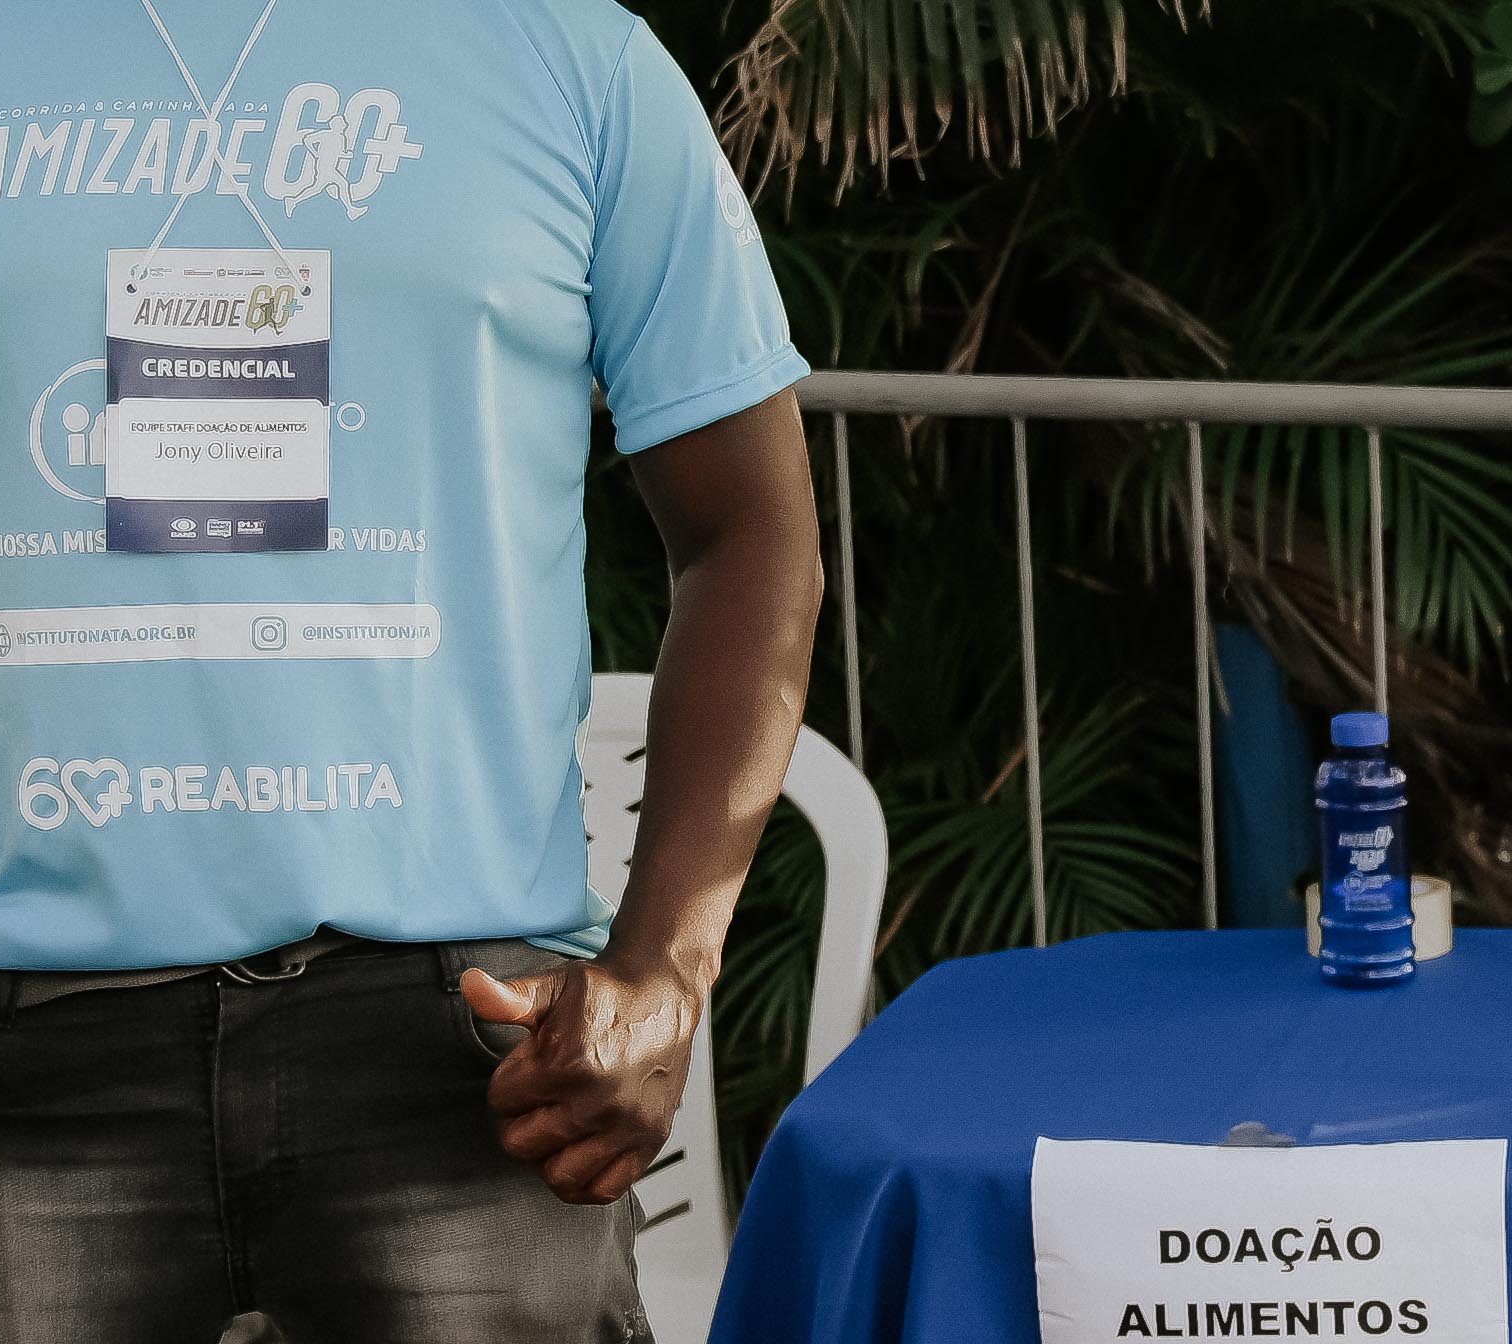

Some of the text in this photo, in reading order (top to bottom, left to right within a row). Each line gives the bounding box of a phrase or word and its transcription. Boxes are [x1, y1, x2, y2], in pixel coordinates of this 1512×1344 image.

[93, 100, 106, 112] &
[242, 101, 270, 114] DA
[133, 297, 246, 328] AMIZADE
[140, 357, 297, 379] CREDENCIAL
[131, 421, 308, 435] EQUIPE STAFF DOAÇÃO DE ALIMENTOS
[154, 441, 284, 464] Jony Oliveira
[350, 526, 428, 553] VIDAS
[138, 762, 406, 814] REABILITA
[1158, 1217, 1383, 1273] DOAÇÃO
[1116, 1298, 1430, 1339] ALIMENTOS
